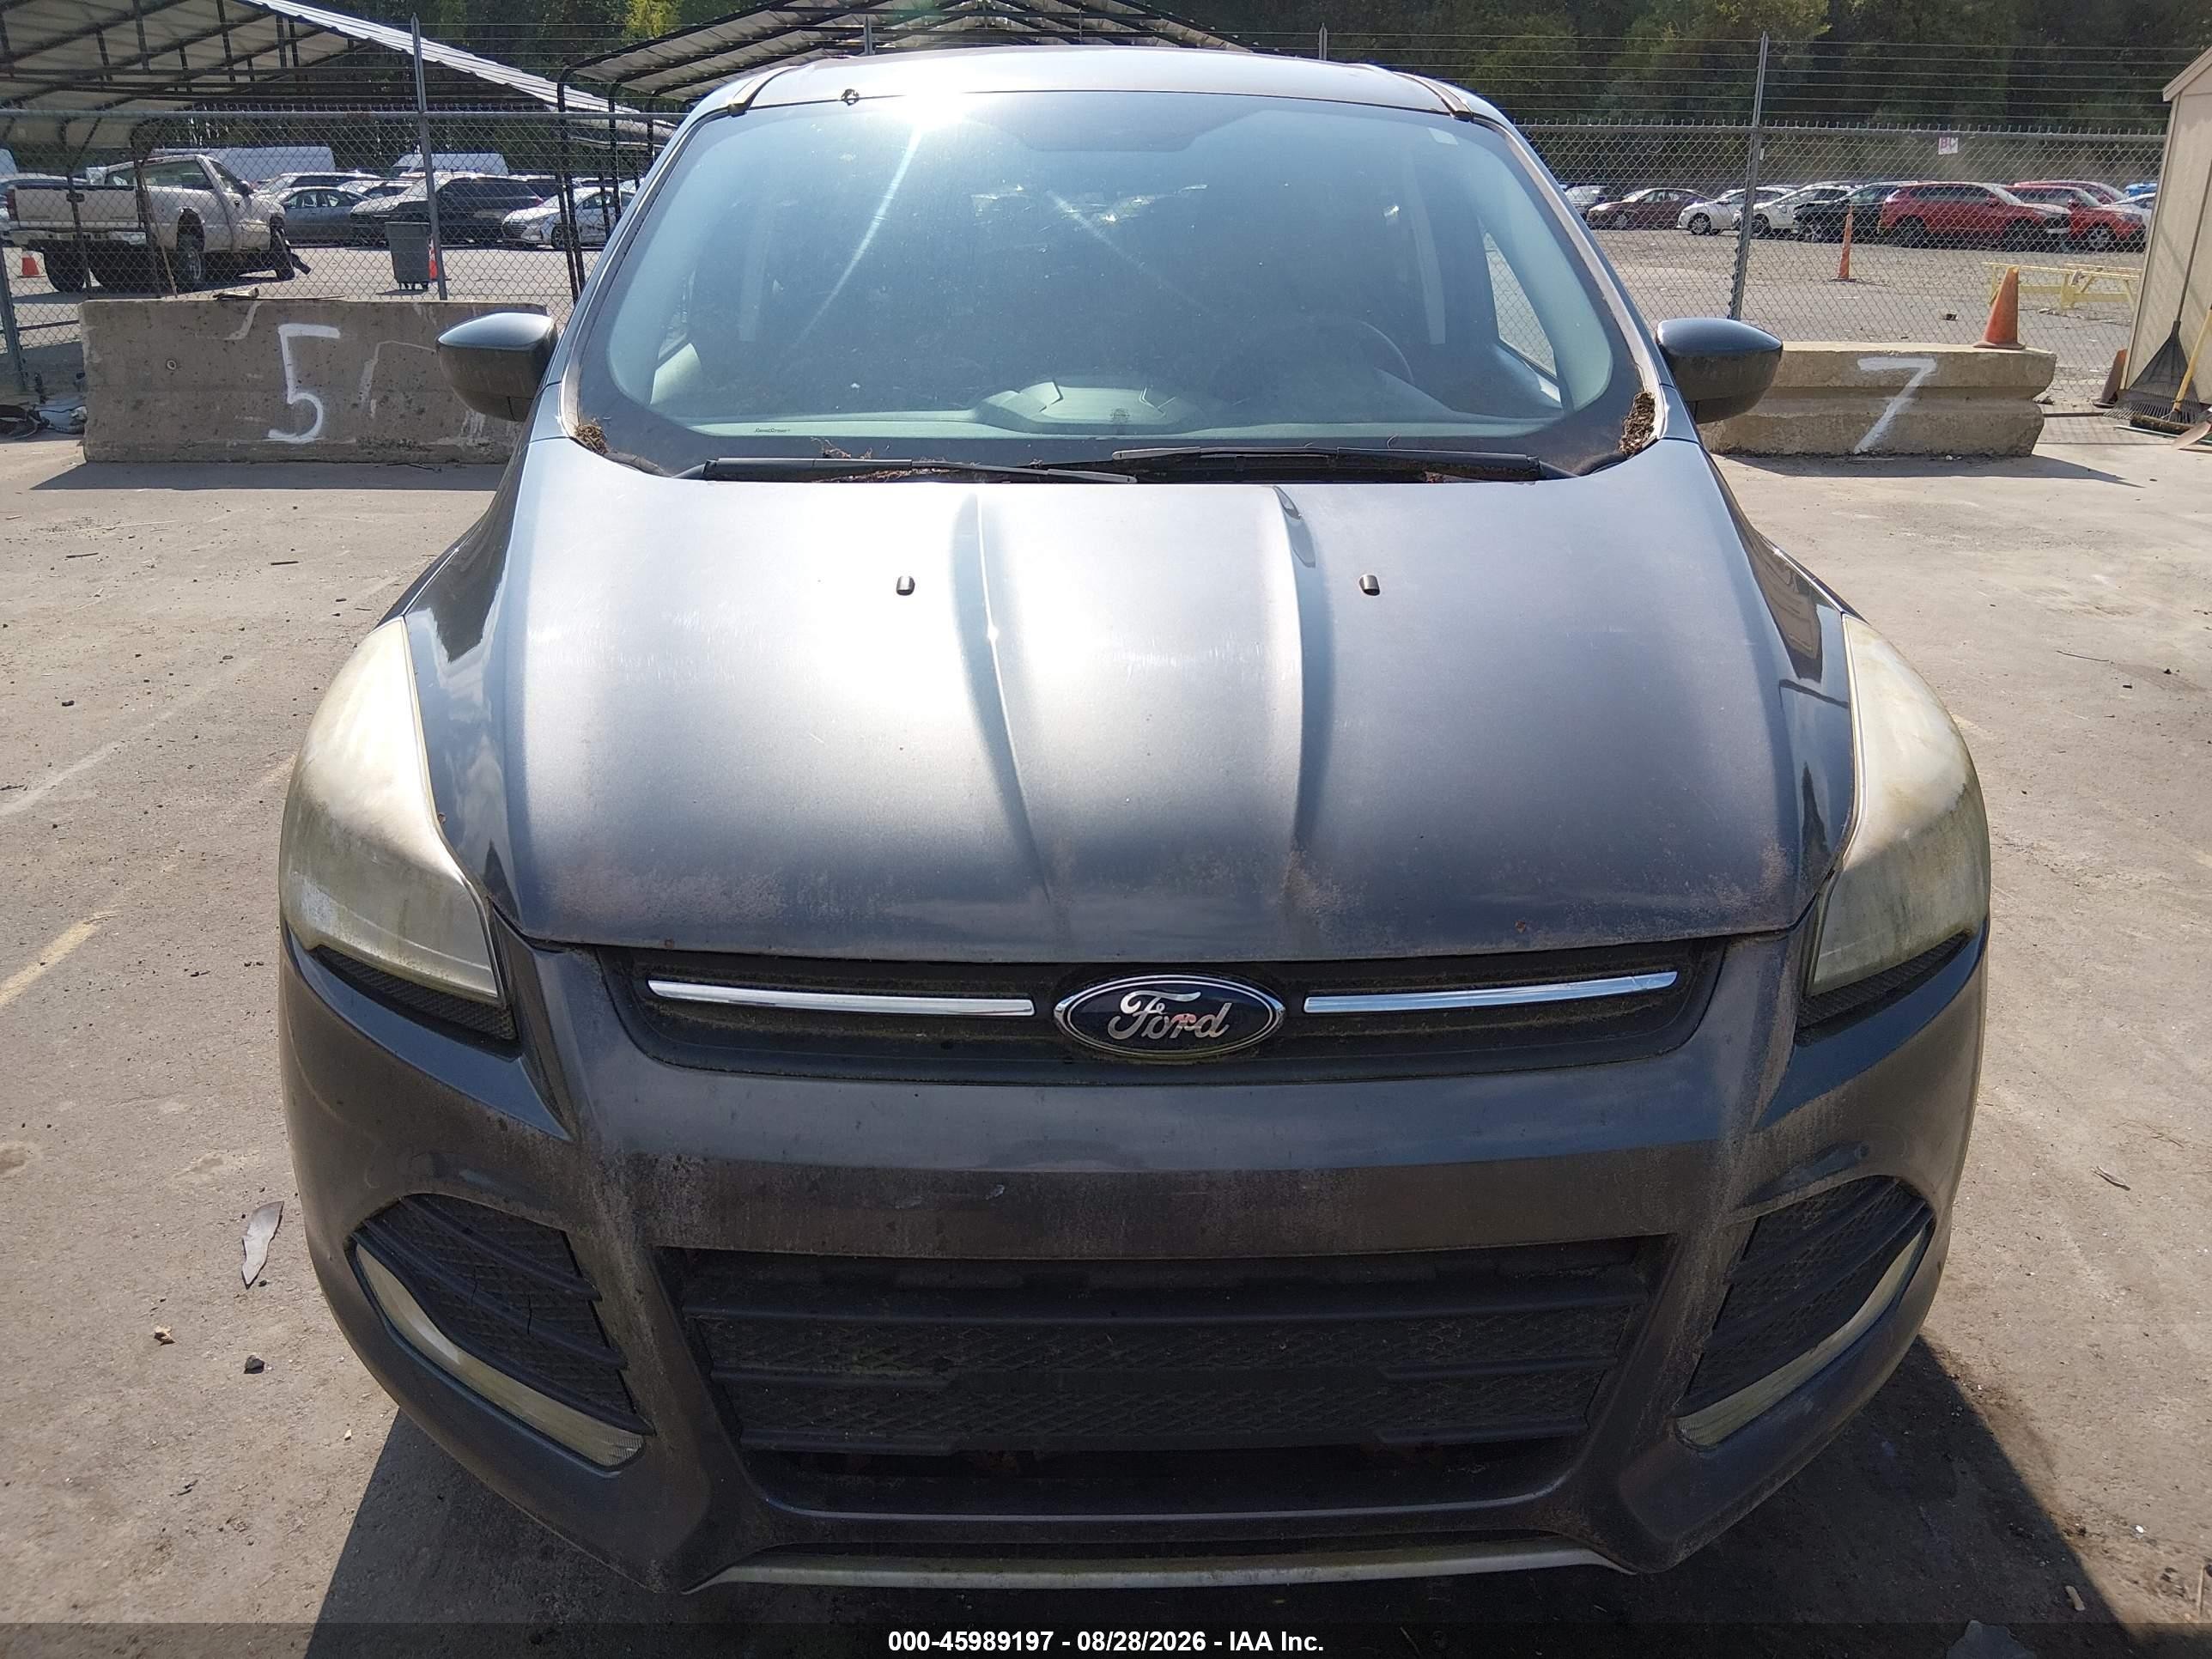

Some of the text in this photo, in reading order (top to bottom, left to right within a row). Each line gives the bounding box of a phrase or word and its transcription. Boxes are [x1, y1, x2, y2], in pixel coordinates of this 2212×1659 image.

[268, 323, 341, 444] 5
[1854, 356, 1937, 454] 7
[1107, 989, 1233, 1040] Ford
